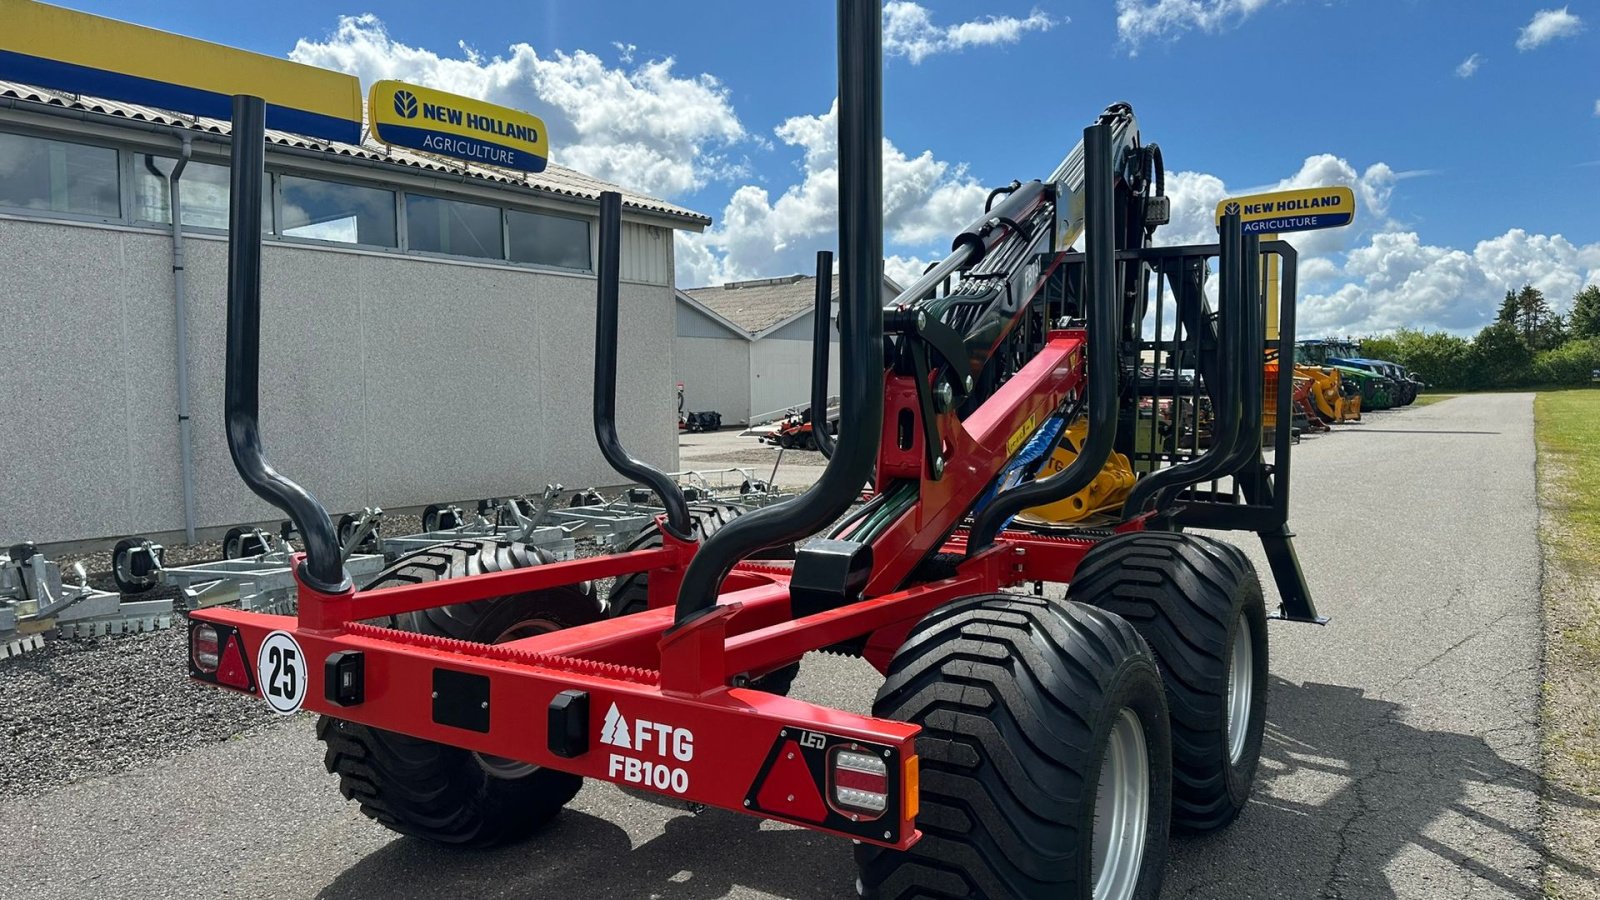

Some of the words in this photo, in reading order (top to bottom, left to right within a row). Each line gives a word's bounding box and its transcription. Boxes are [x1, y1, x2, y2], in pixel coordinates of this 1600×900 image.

[423, 103, 463, 126] NEW
[467, 113, 538, 143] HOLLAND
[422, 135, 514, 164] AGRICULTURE
[1244, 202, 1274, 214] NEW
[1277, 195, 1341, 211] HOLLAND
[1244, 216, 1317, 231] AGRICULTURE
[269, 646, 296, 700] 25
[635, 718, 694, 762] FTG
[799, 731, 826, 750] LED
[609, 753, 689, 793] FB100
